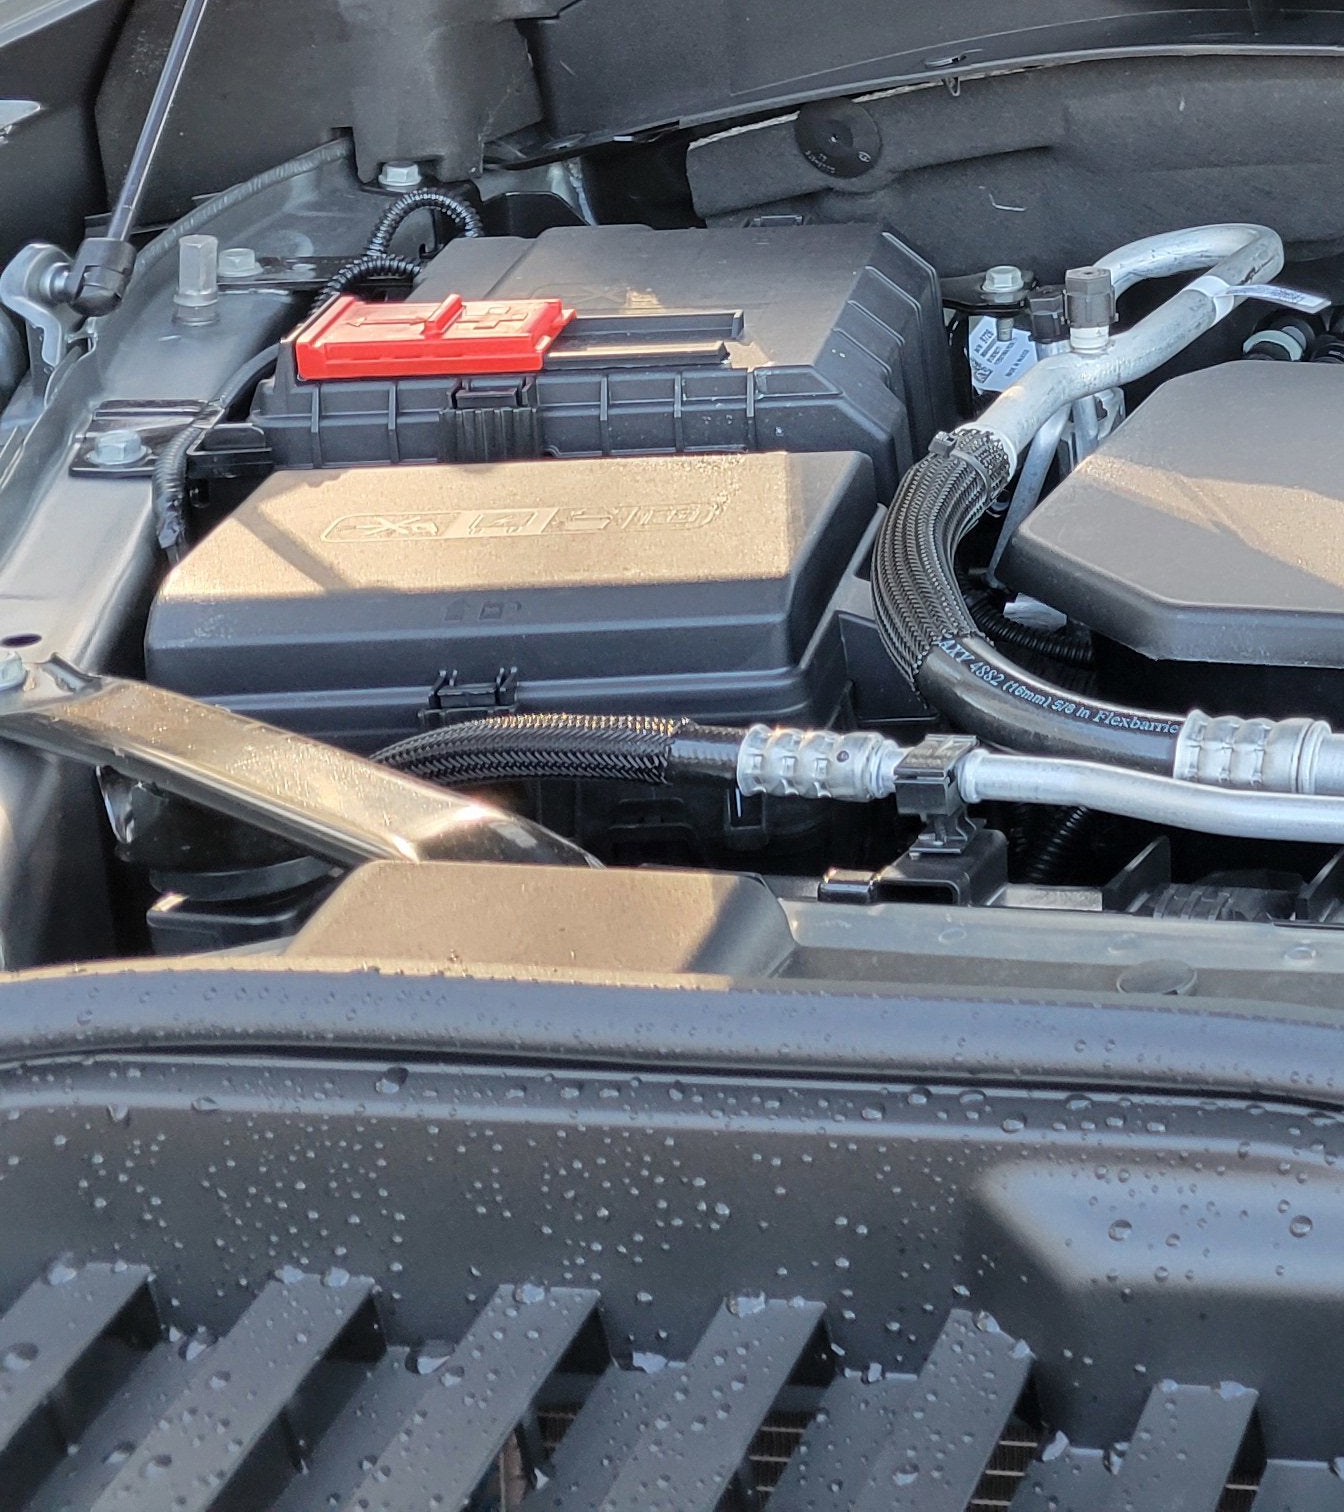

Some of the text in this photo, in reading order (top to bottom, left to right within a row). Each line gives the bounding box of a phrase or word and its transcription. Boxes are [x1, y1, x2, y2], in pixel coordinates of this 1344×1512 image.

[970, 661, 1005, 686] 4882
[1002, 680, 1052, 708] (16mm)
[1092, 709, 1182, 734] Flexbarrie
